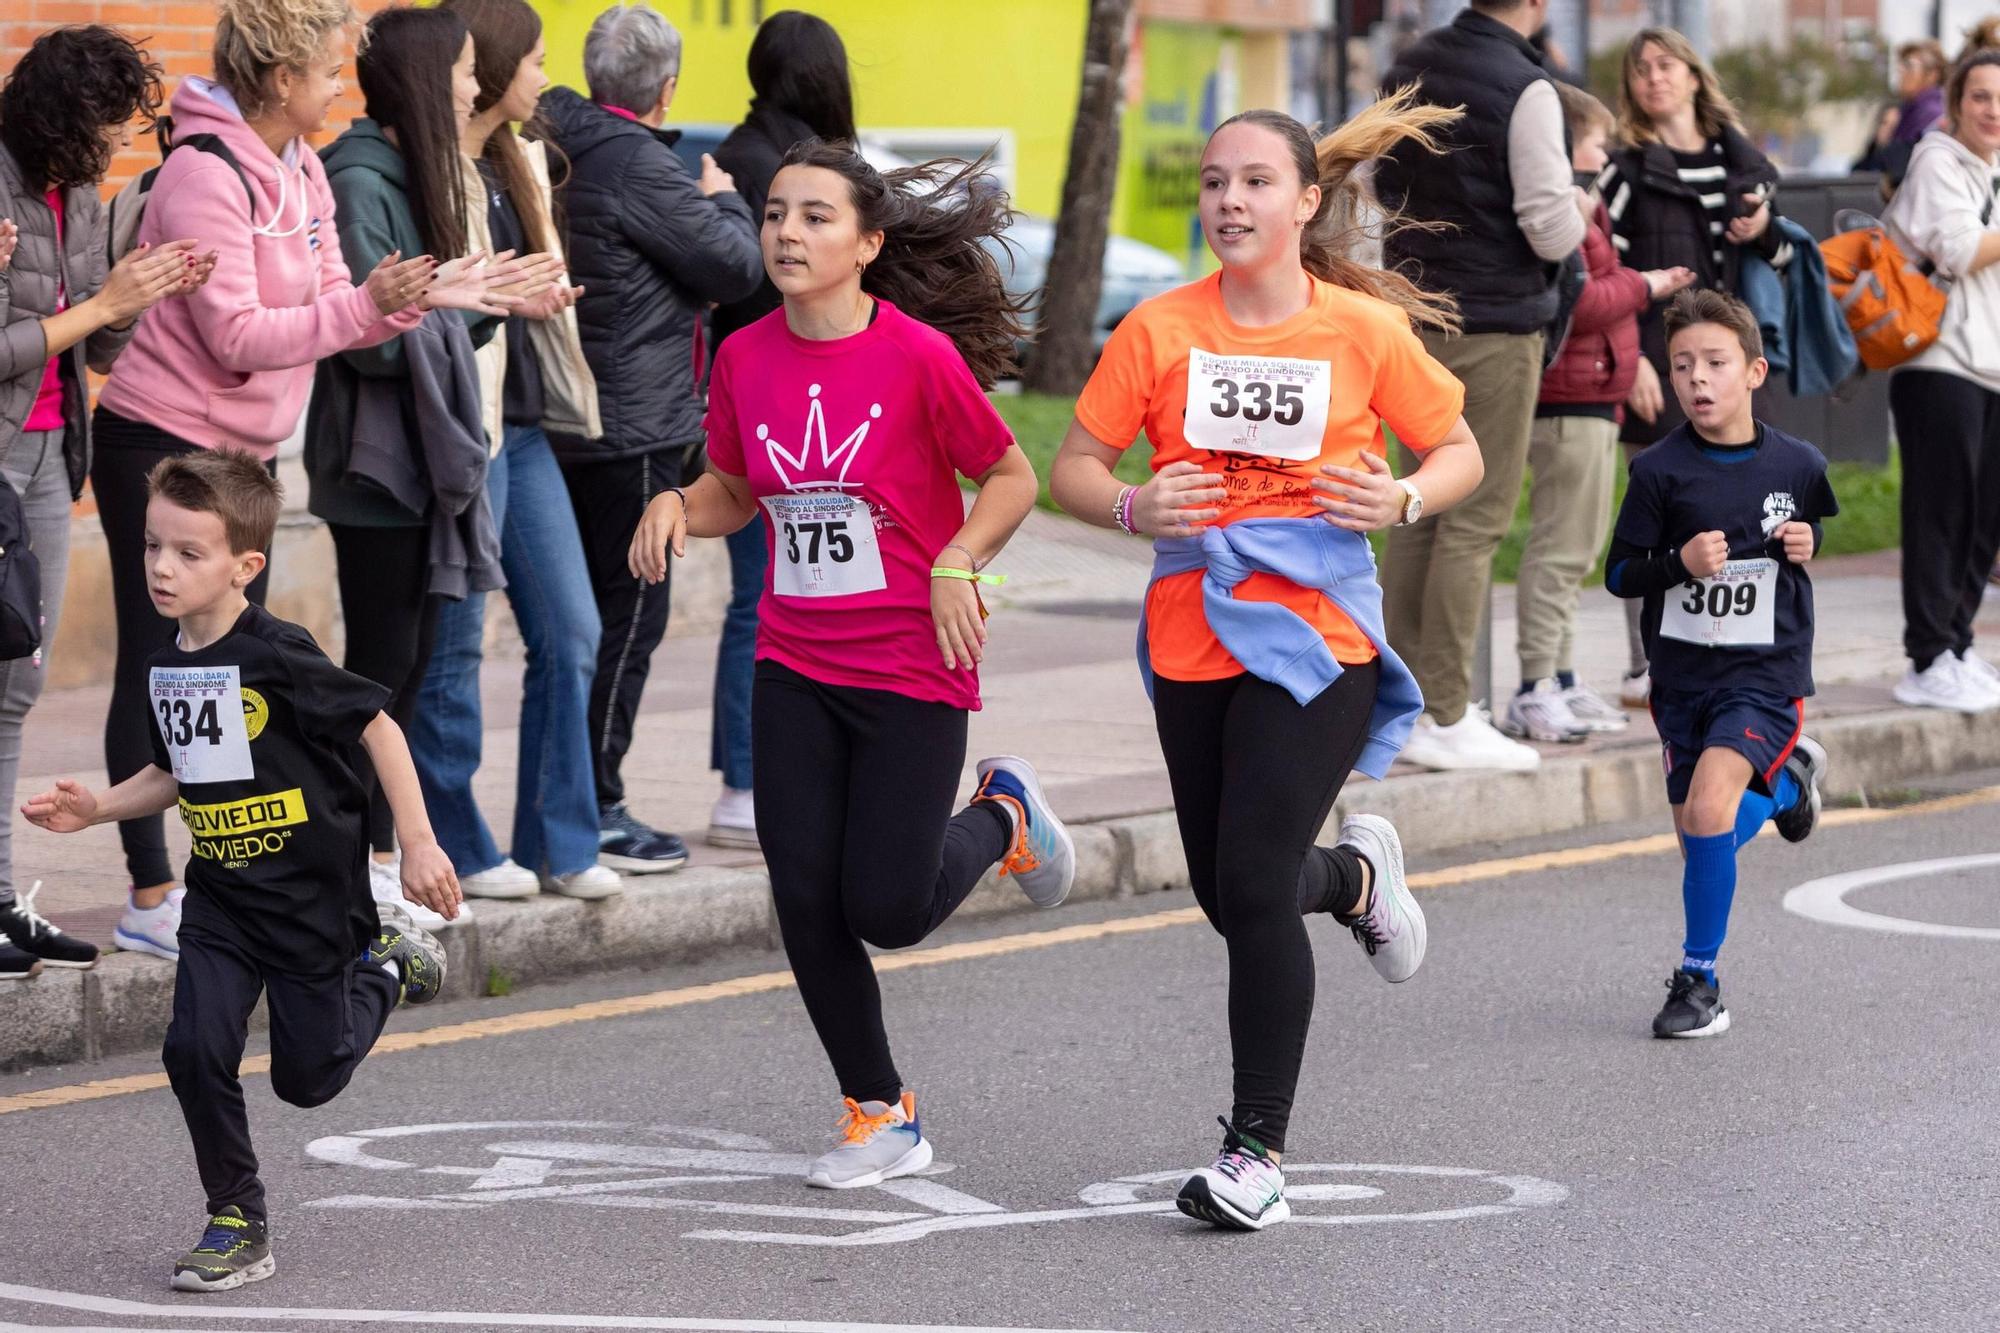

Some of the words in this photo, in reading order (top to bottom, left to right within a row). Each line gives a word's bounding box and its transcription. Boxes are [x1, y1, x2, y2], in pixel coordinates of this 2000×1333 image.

[1202, 362, 1252, 374] RETTANDO
[1267, 368, 1315, 378] SINDROME
[1208, 358, 1238, 367] DOBLE
[1240, 360, 1269, 368] MILLA
[1271, 360, 1320, 371] SOLIDARIA
[1201, 368, 1238, 379] DE
[1245, 374, 1317, 384] RETT
[1210, 378, 1304, 426] 335
[1256, 474, 1274, 493] de
[776, 512, 793, 520] DE
[797, 509, 856, 521] RETT
[814, 503, 854, 513] SINDROME
[784, 521, 854, 564] 375
[1730, 567, 1766, 576] SINDROME
[1681, 579, 1757, 617] 309
[170, 672, 187, 681] MILLA
[188, 671, 231, 681] SOLIDARIA
[176, 681, 185, 689] AL
[185, 680, 227, 689] SINDROME
[154, 688, 170, 697] DE
[173, 688, 228, 697] RETT
[159, 698, 223, 746] 334
